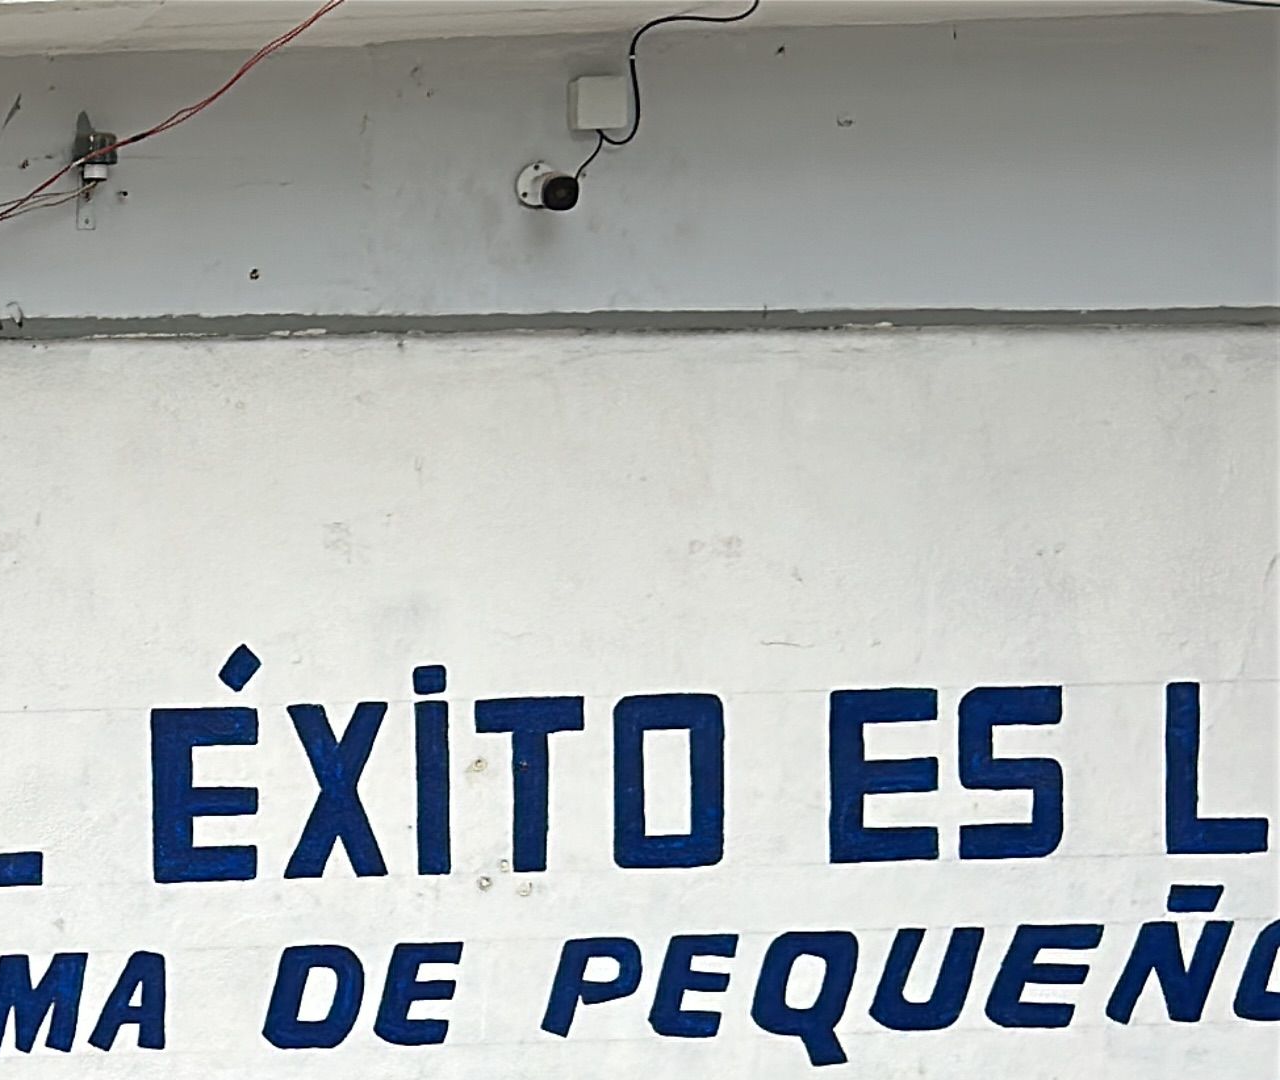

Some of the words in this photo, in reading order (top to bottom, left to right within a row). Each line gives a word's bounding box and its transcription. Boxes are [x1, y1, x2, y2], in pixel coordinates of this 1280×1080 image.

[827, 685, 1064, 864] ES
[1165, 681, 1270, 855] L
[262, 941, 464, 1050] DE
